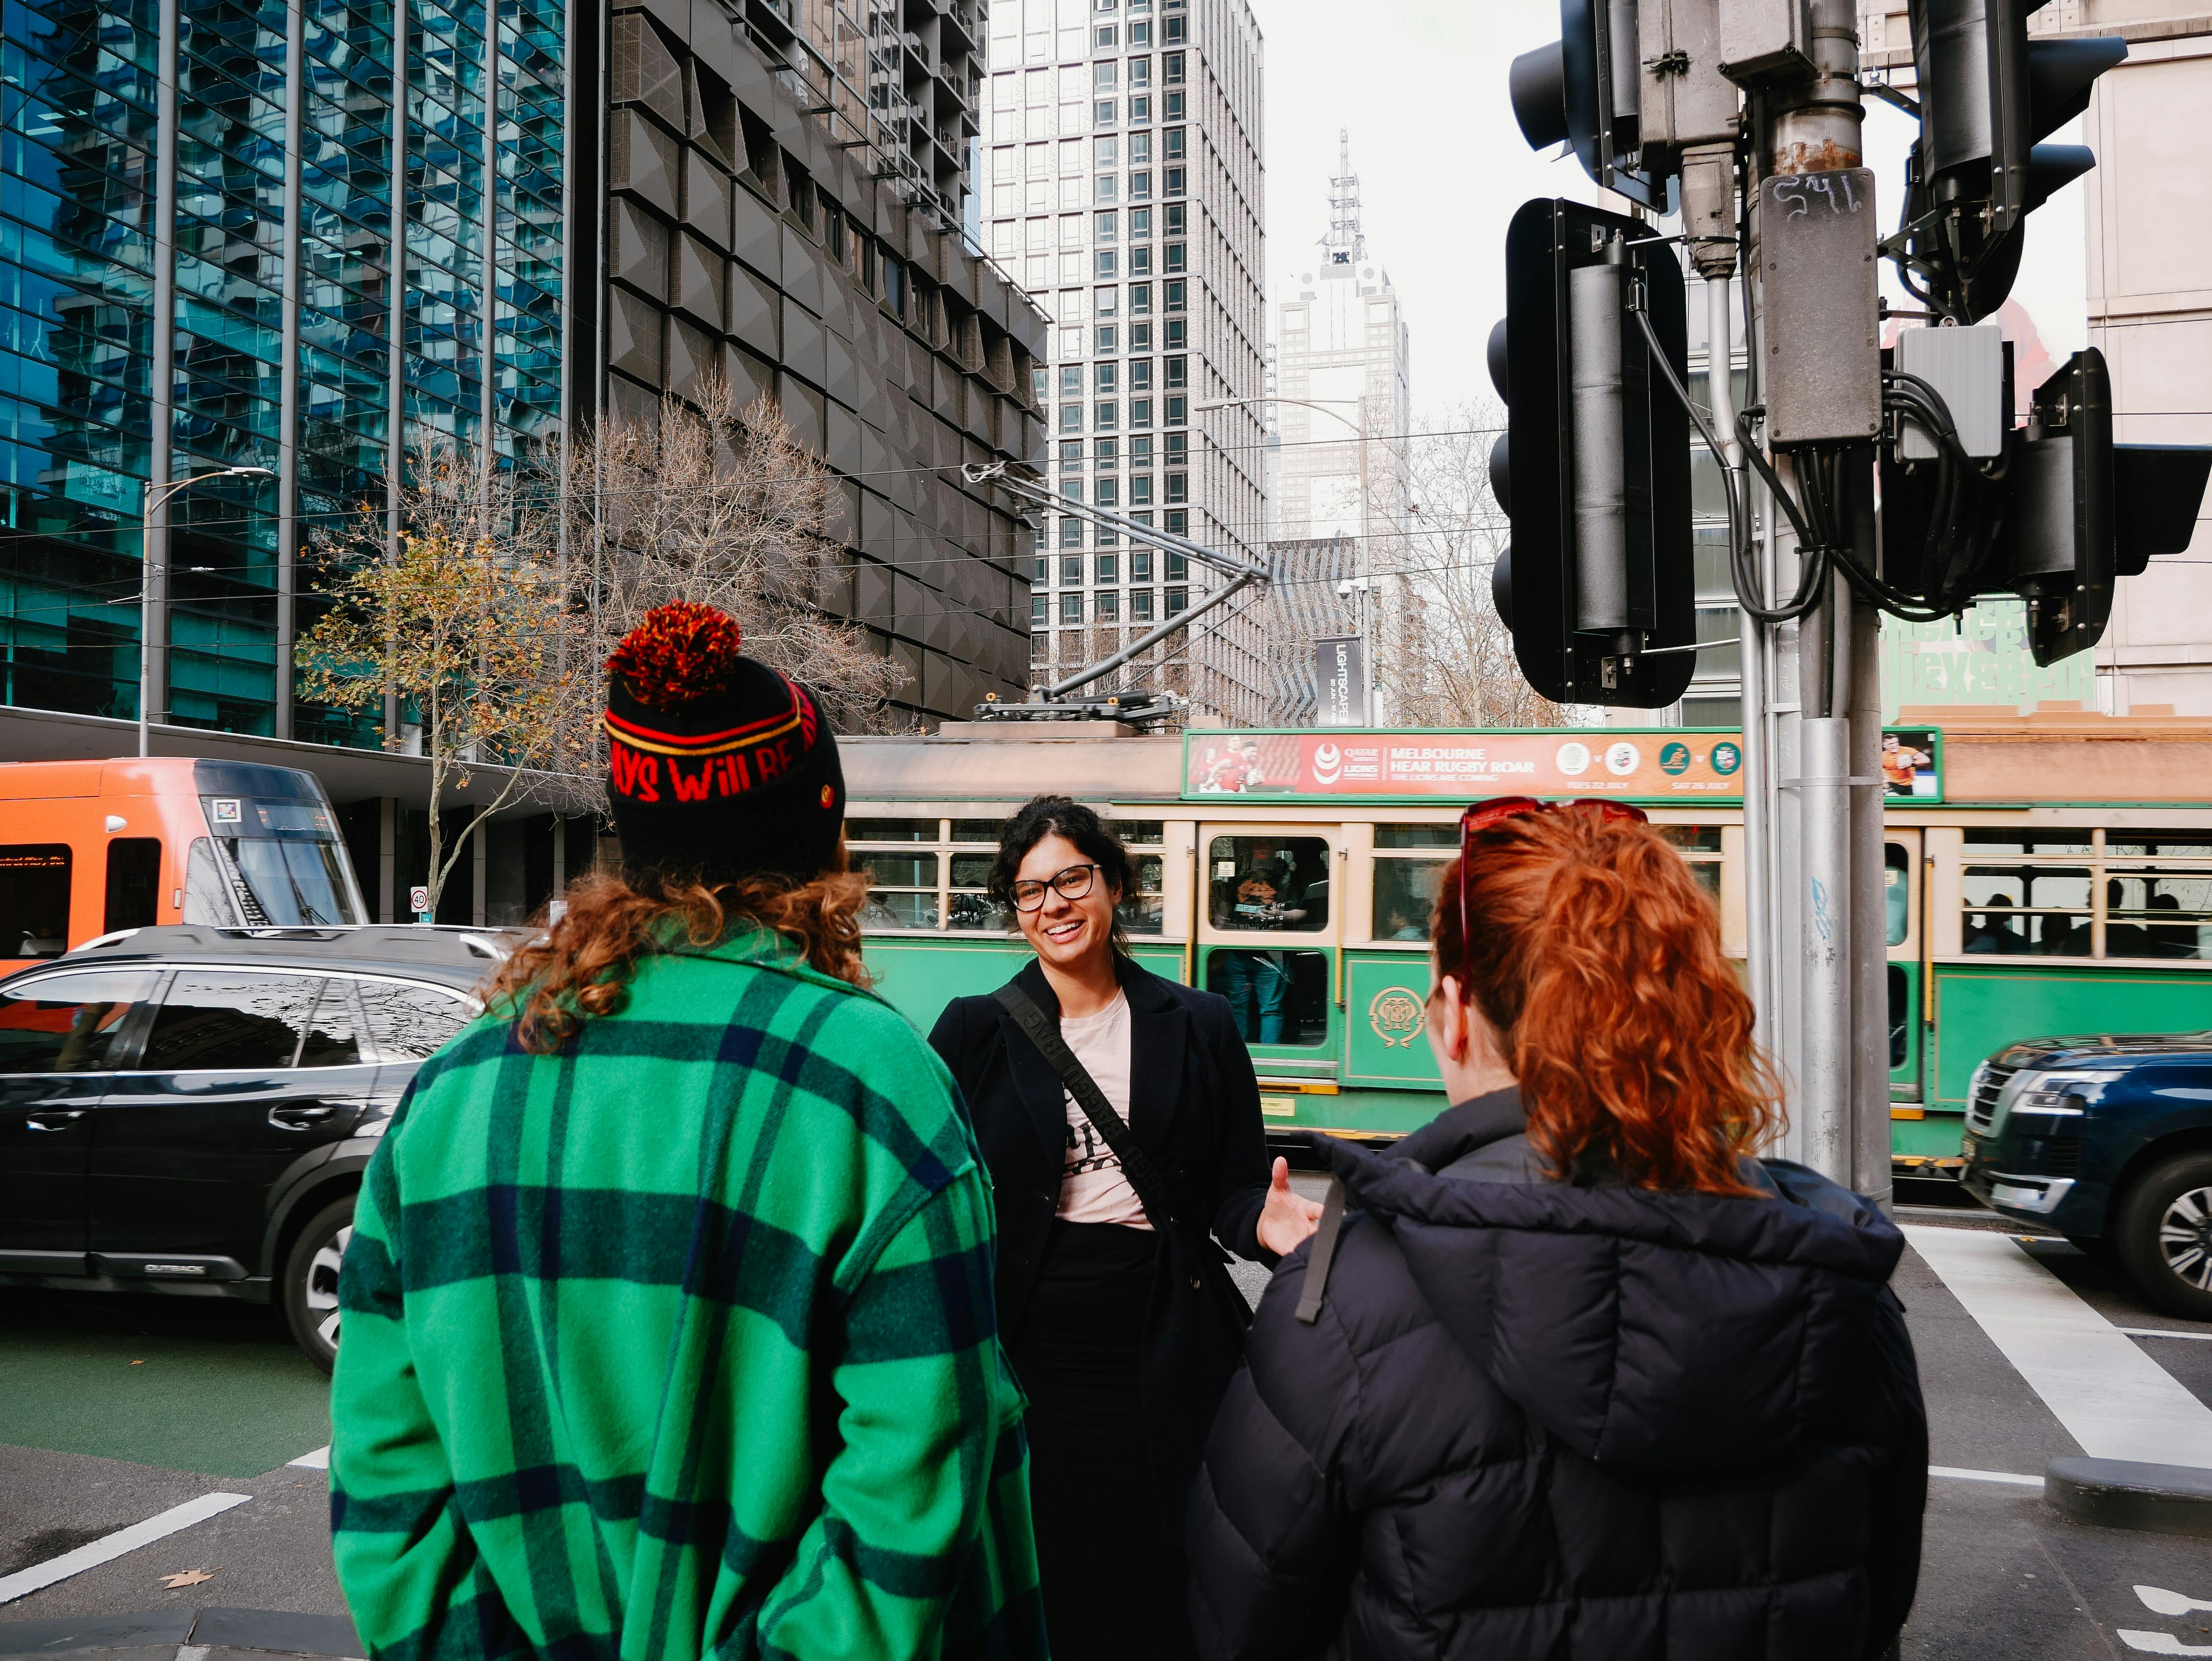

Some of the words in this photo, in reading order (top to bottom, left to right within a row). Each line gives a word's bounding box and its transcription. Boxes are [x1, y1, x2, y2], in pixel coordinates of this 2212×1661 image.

[1330, 678, 1336, 686] 20
[1390, 748, 1486, 760] MELBOURNE
[1343, 764, 1379, 773] LIONS
[1390, 761, 1432, 772] HEAR
[1434, 761, 1488, 773] RUGBY
[1490, 762, 1535, 773] ROAR
[666, 753, 751, 802] Will
[414, 895, 424, 903] 40
[145, 1265, 206, 1274] OUTBACK
